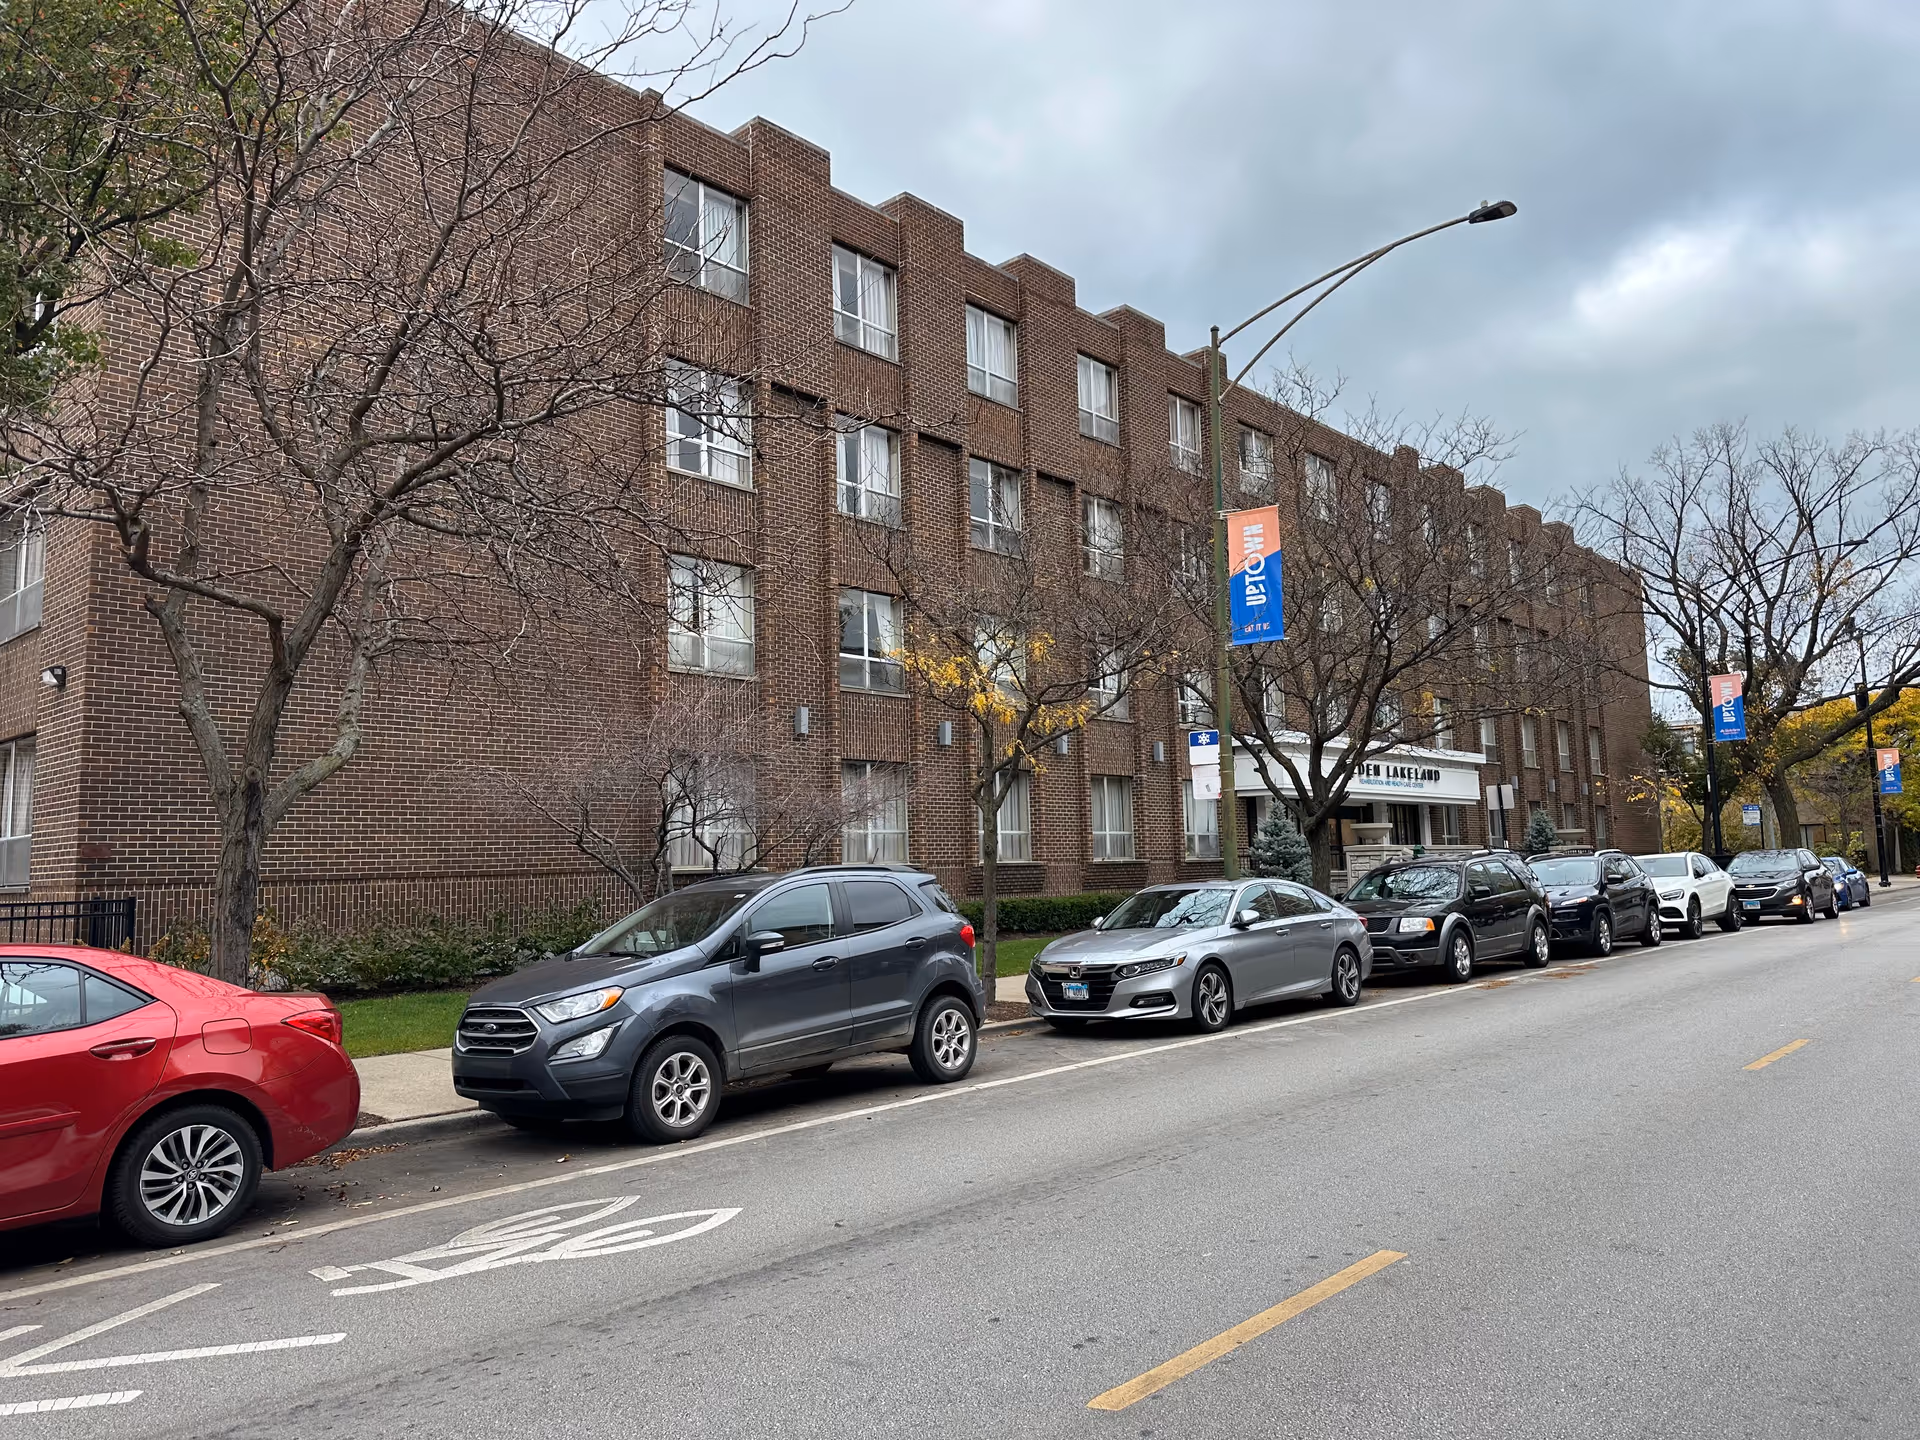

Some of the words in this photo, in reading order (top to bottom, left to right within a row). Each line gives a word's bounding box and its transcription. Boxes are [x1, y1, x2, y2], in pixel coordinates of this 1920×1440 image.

[1243, 523, 1266, 607] UPTOWN
[1720, 681, 1736, 722] UPTOWN
[1354, 763, 1381, 777] DEN
[1386, 765, 1440, 781] LAKELAND
[1883, 753, 1895, 781] UPTOWN
